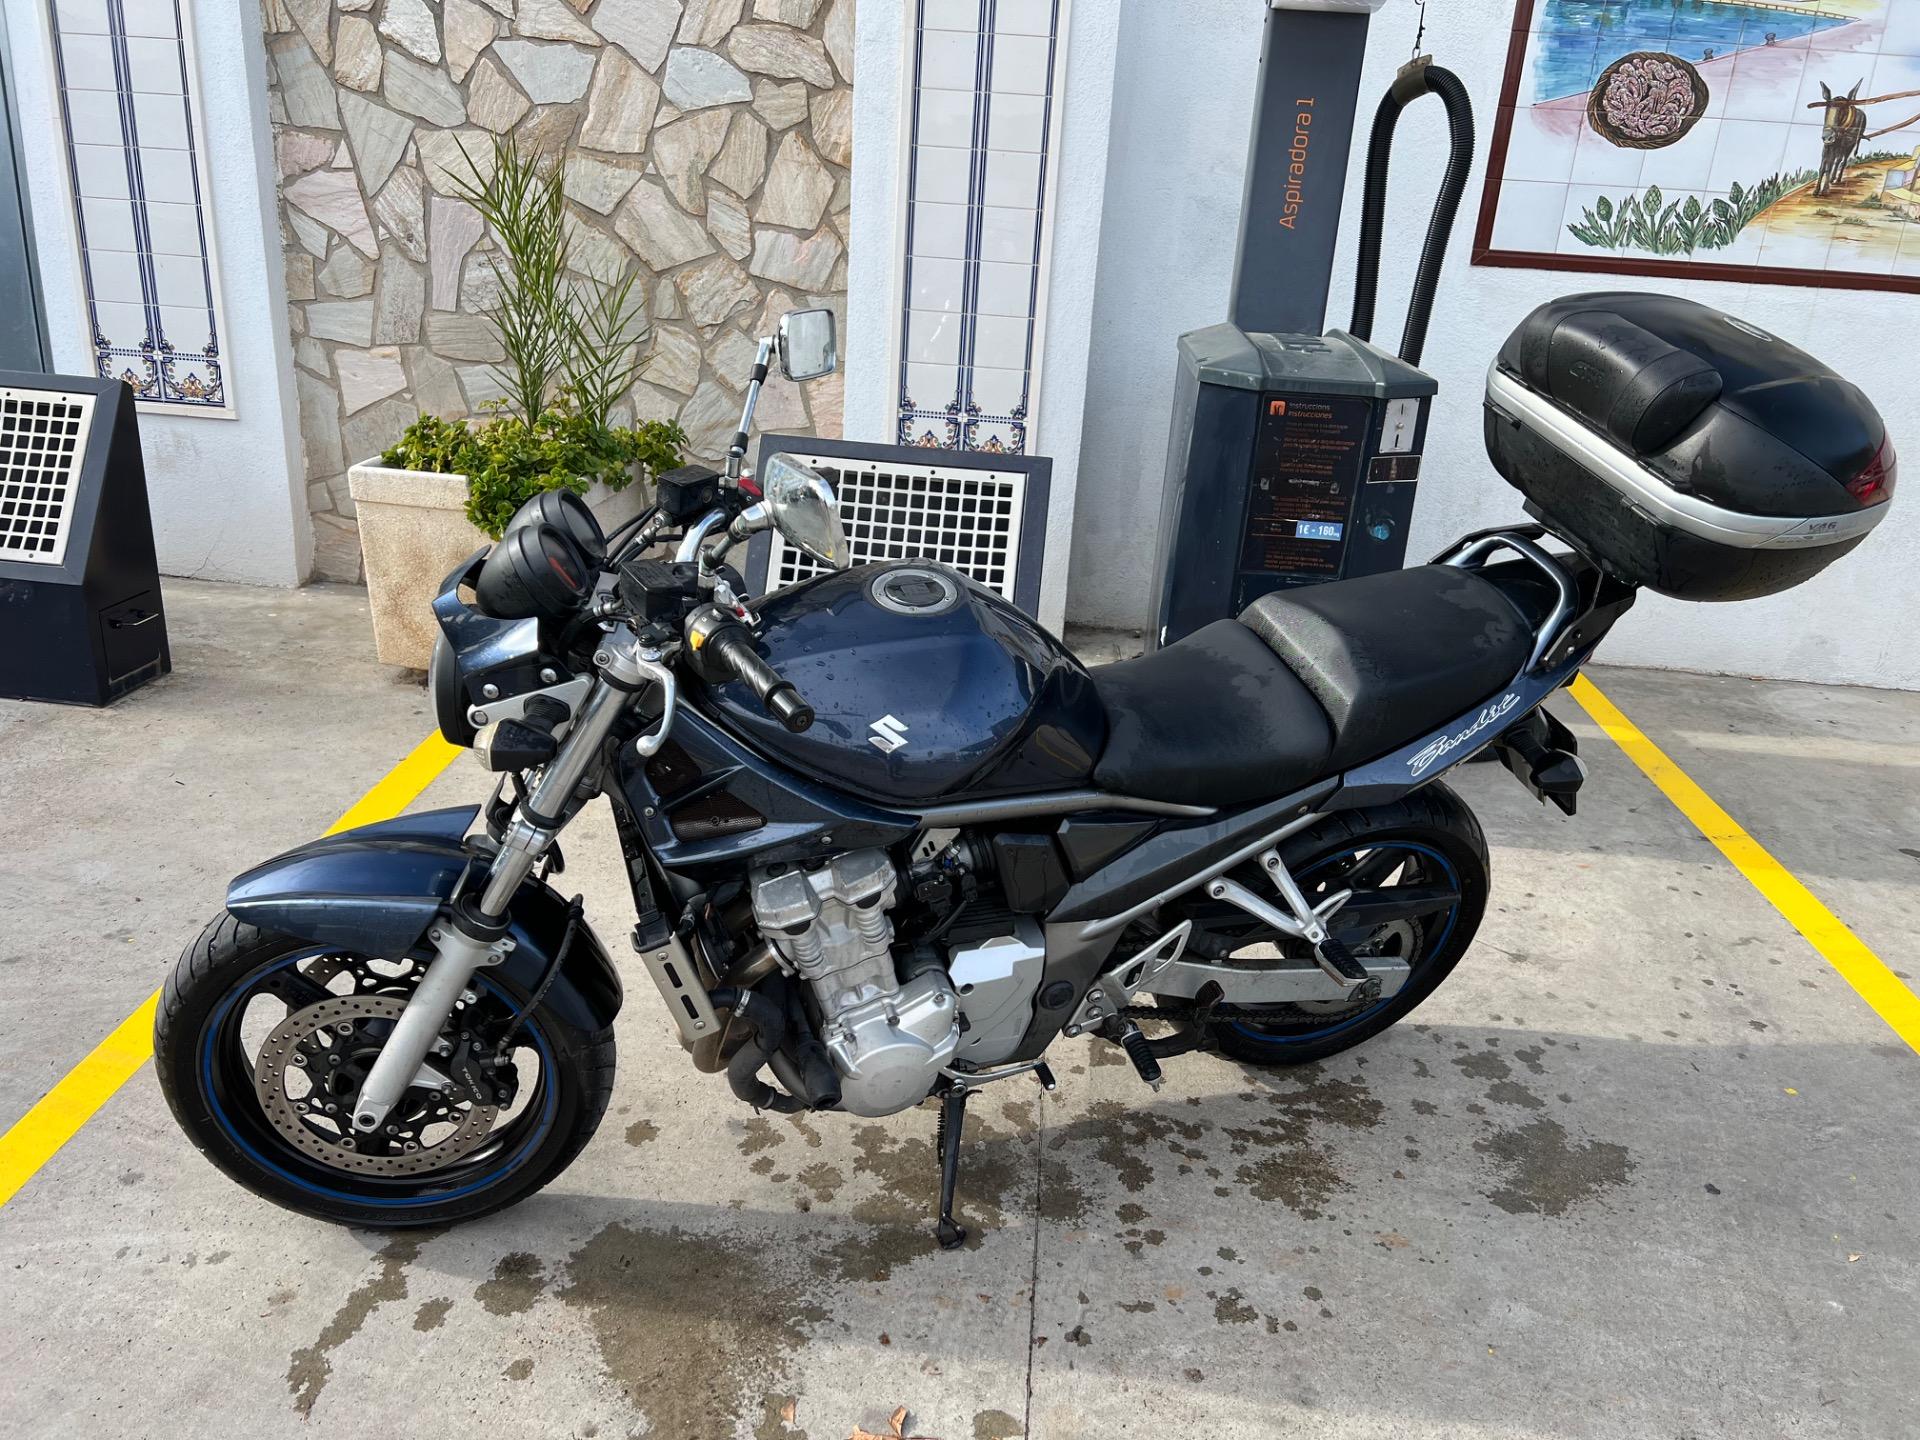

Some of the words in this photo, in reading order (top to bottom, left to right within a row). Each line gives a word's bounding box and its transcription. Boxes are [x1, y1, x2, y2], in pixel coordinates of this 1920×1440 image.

[1279, 113, 1313, 230] Aspiradora
[1296, 97, 1315, 107] 1
[1299, 524, 1310, 535] 1€
[1406, 693, 1521, 777] Bandit
[462, 1066, 482, 1100] TOKICO
